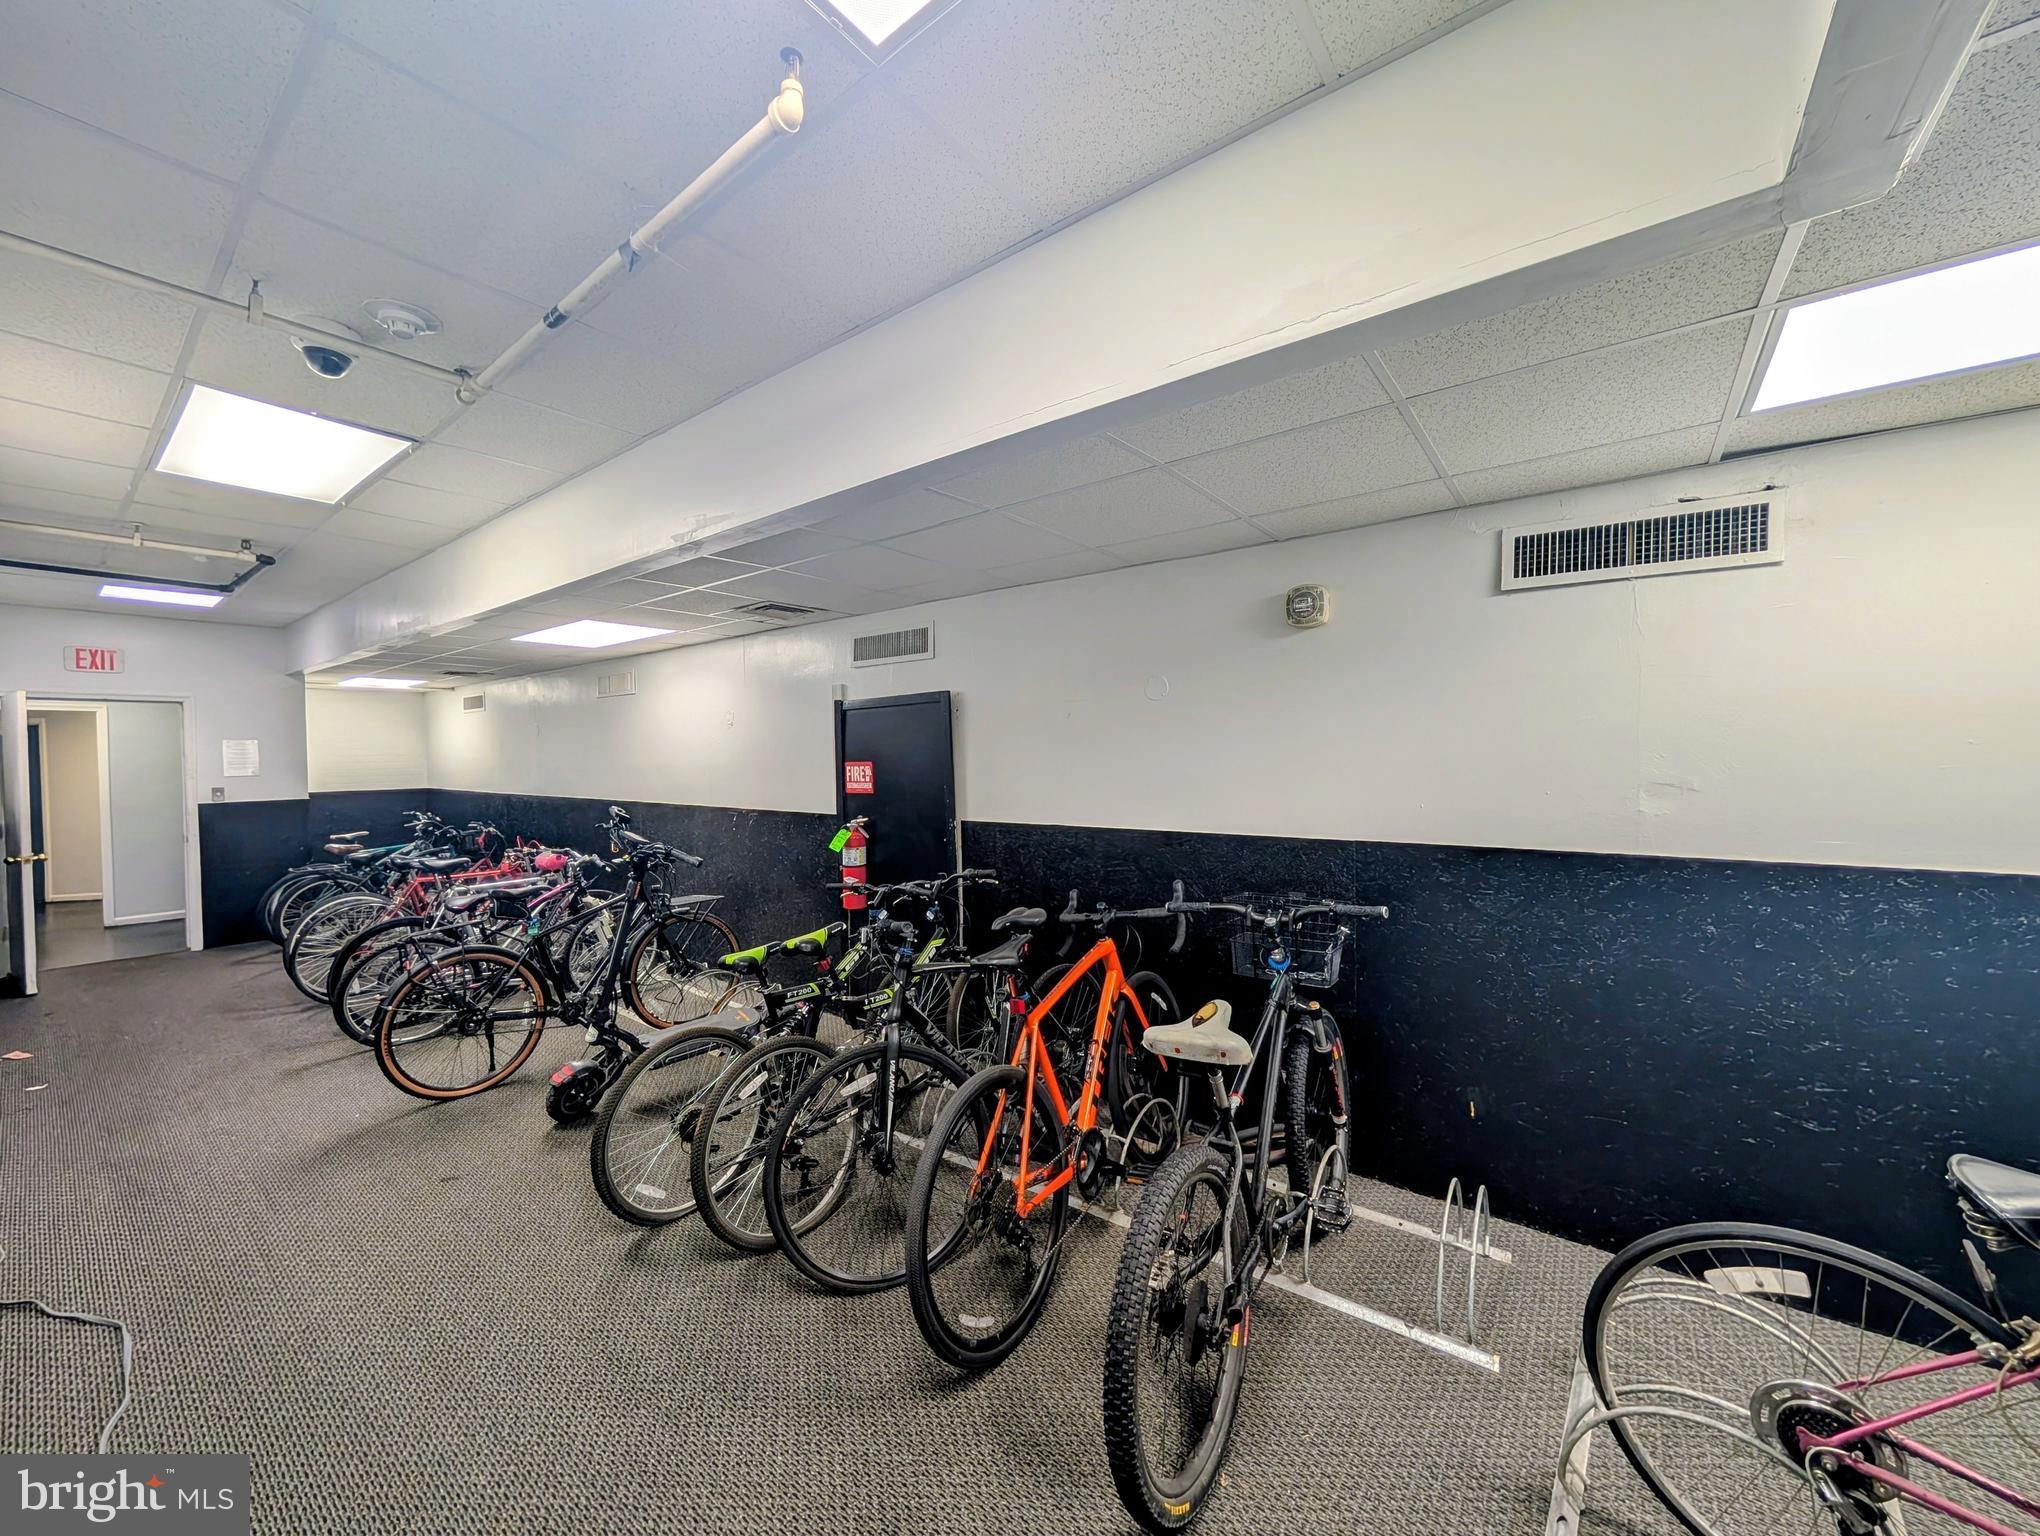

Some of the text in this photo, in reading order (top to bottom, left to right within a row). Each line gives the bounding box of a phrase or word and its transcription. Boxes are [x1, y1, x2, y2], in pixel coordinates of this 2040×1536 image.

[75, 647, 118, 671] EXIT
[846, 766, 865, 782] FIRE
[787, 986, 812, 999] FT200
